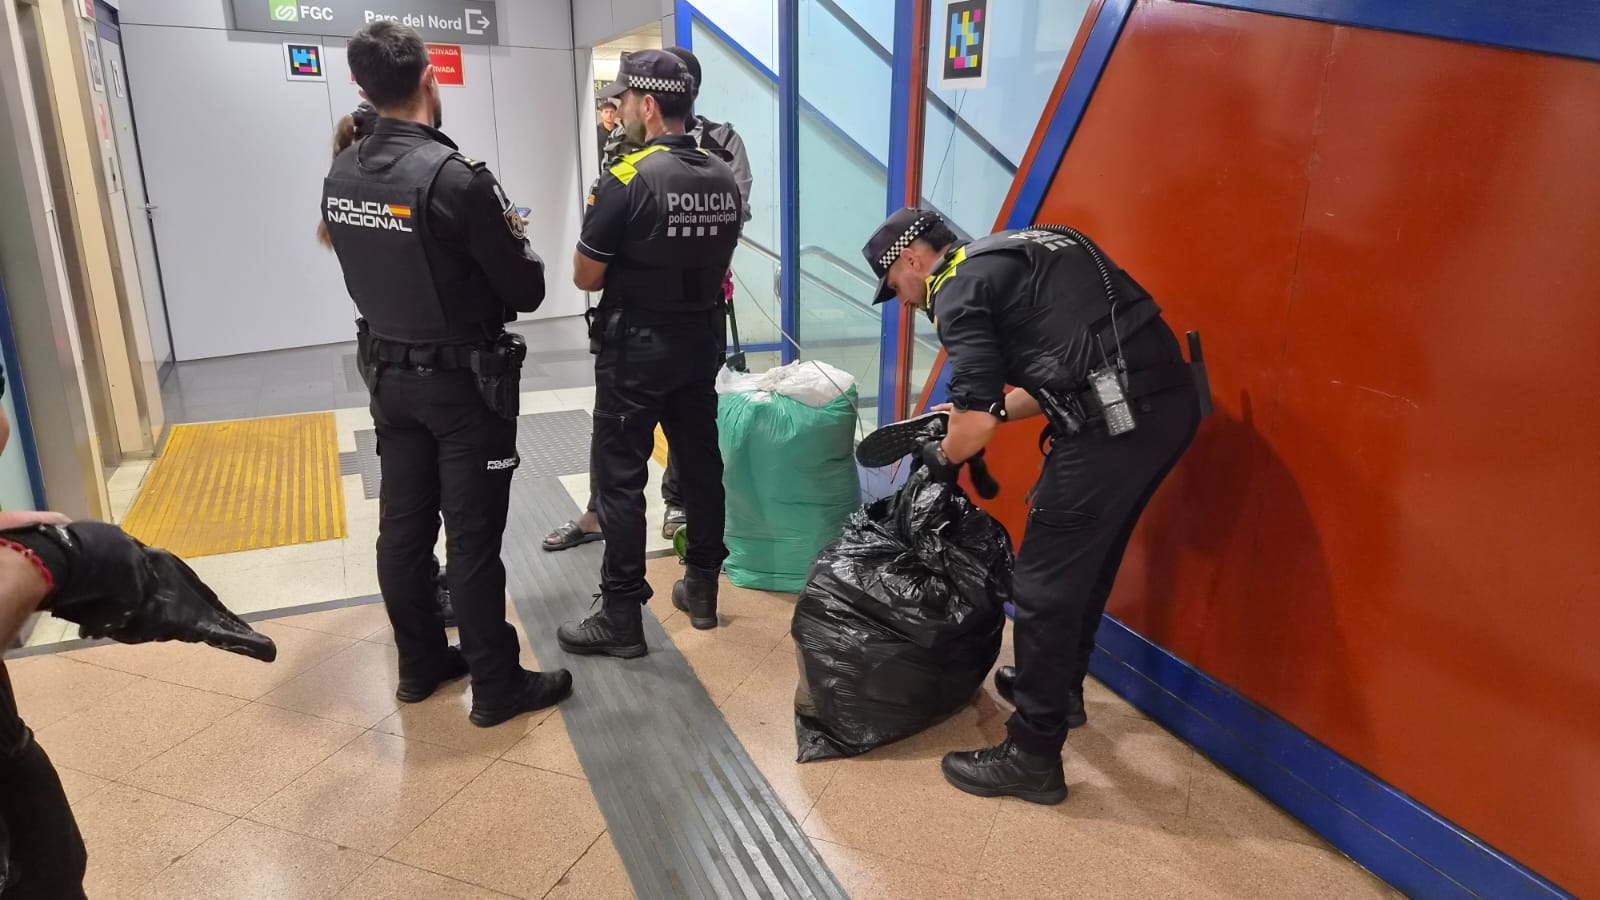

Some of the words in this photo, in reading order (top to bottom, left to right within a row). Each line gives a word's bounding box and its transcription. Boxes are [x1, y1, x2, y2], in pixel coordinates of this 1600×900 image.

[300, 5, 334, 21] FGC
[402, 13, 425, 28] del
[428, 15, 463, 30] Nord
[327, 196, 393, 216] POLICIA
[666, 192, 737, 212] POLICIA
[327, 210, 413, 232] NACIONAL
[668, 212, 697, 226] policia
[699, 210, 737, 224] municipal
